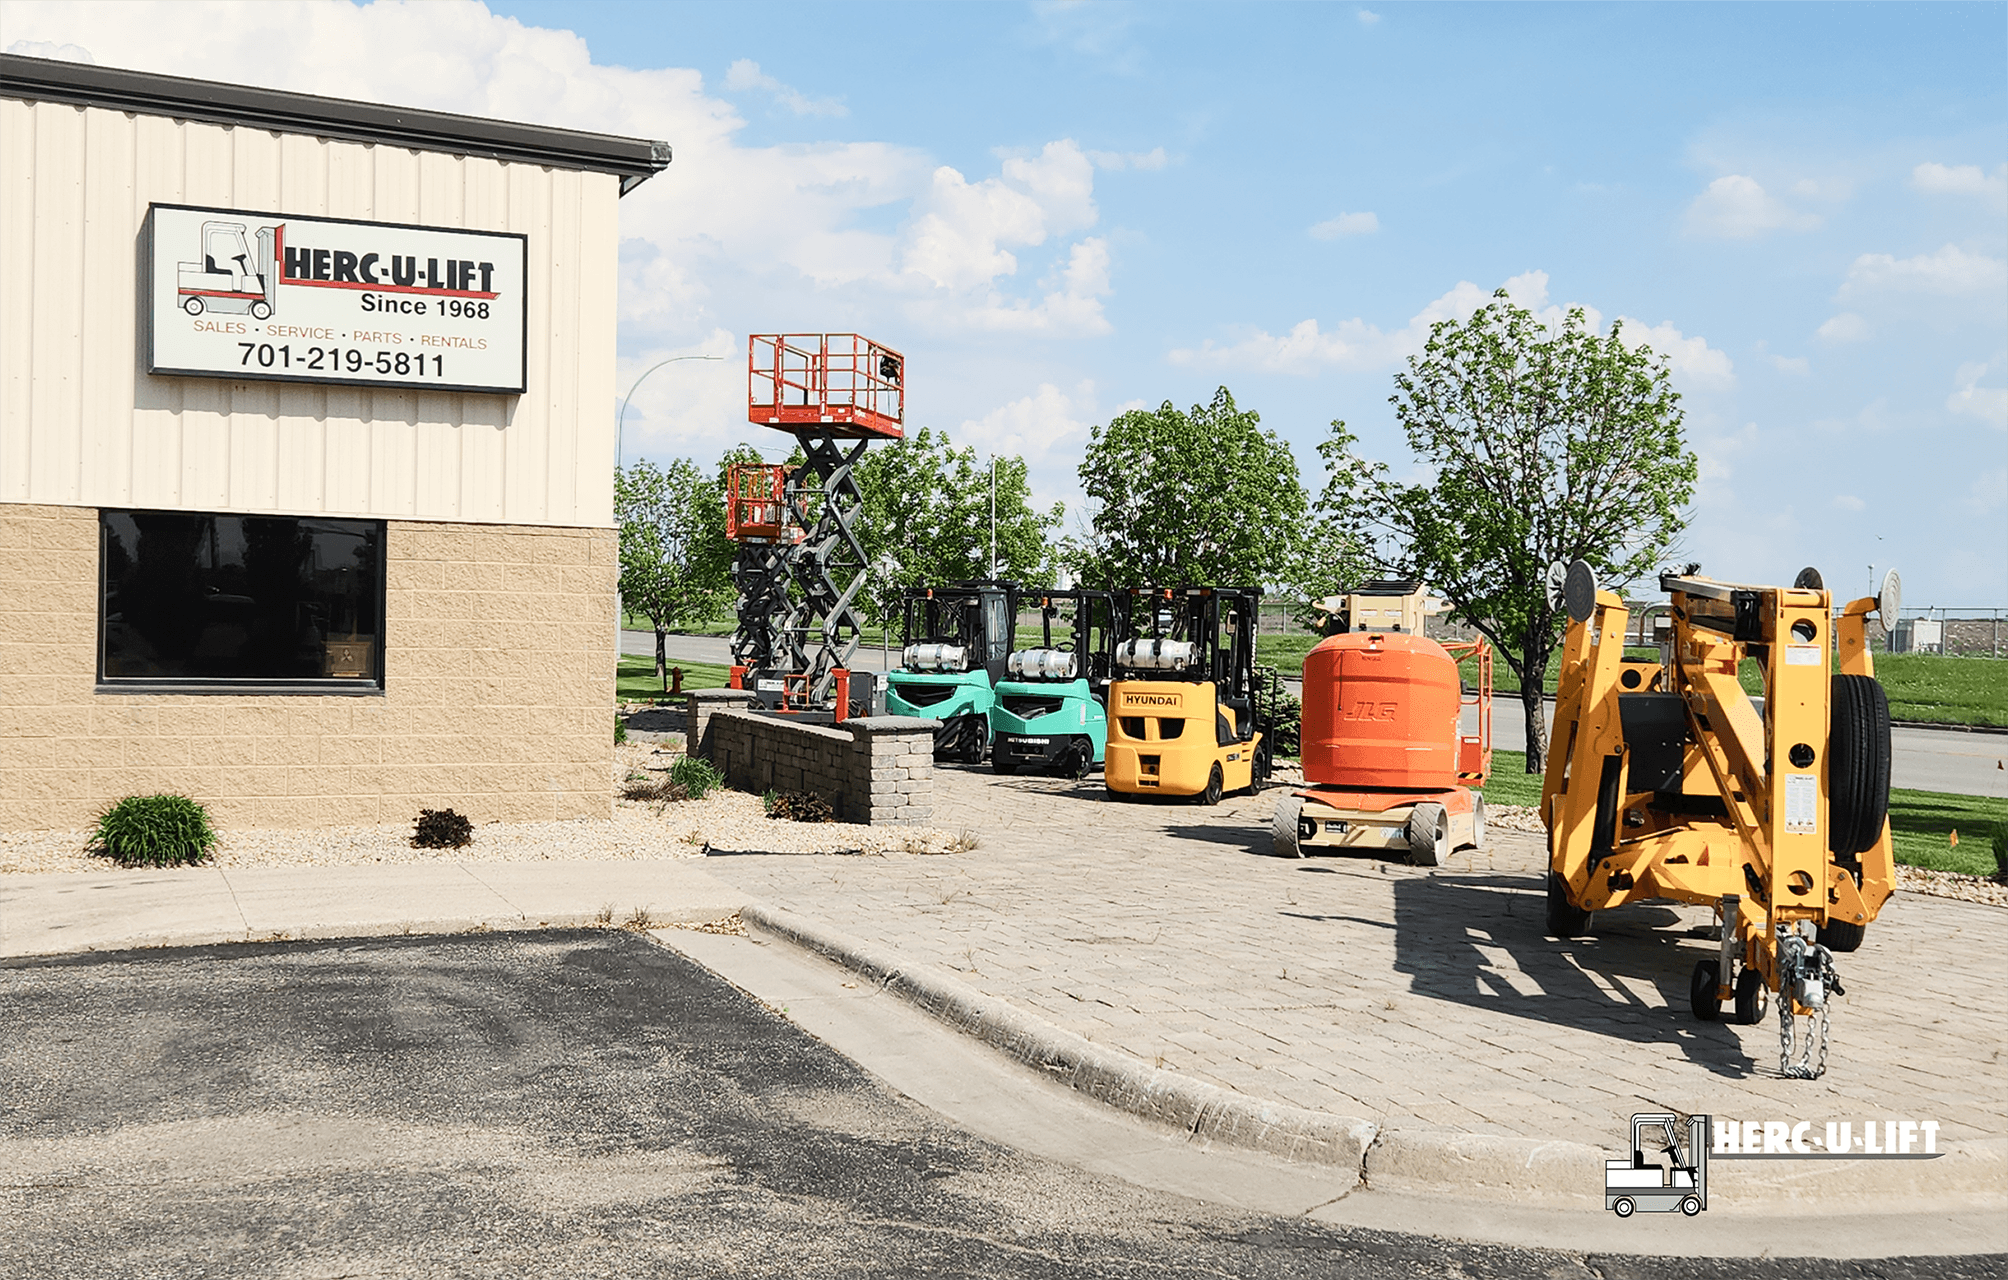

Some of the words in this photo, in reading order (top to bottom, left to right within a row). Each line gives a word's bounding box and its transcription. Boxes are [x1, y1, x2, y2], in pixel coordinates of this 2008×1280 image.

[284, 246, 495, 293] HERC-U-LIFT
[361, 293, 427, 315] Since
[437, 300, 491, 320] 1968
[193, 319, 247, 335] SALES
[266, 324, 335, 341] SERVICE
[353, 330, 403, 345] PARTS
[421, 334, 488, 350] RENTALS
[237, 342, 444, 378] 701-219-5811
[1126, 695, 1177, 706] HYUNDAI
[1343, 701, 1398, 721] JLG
